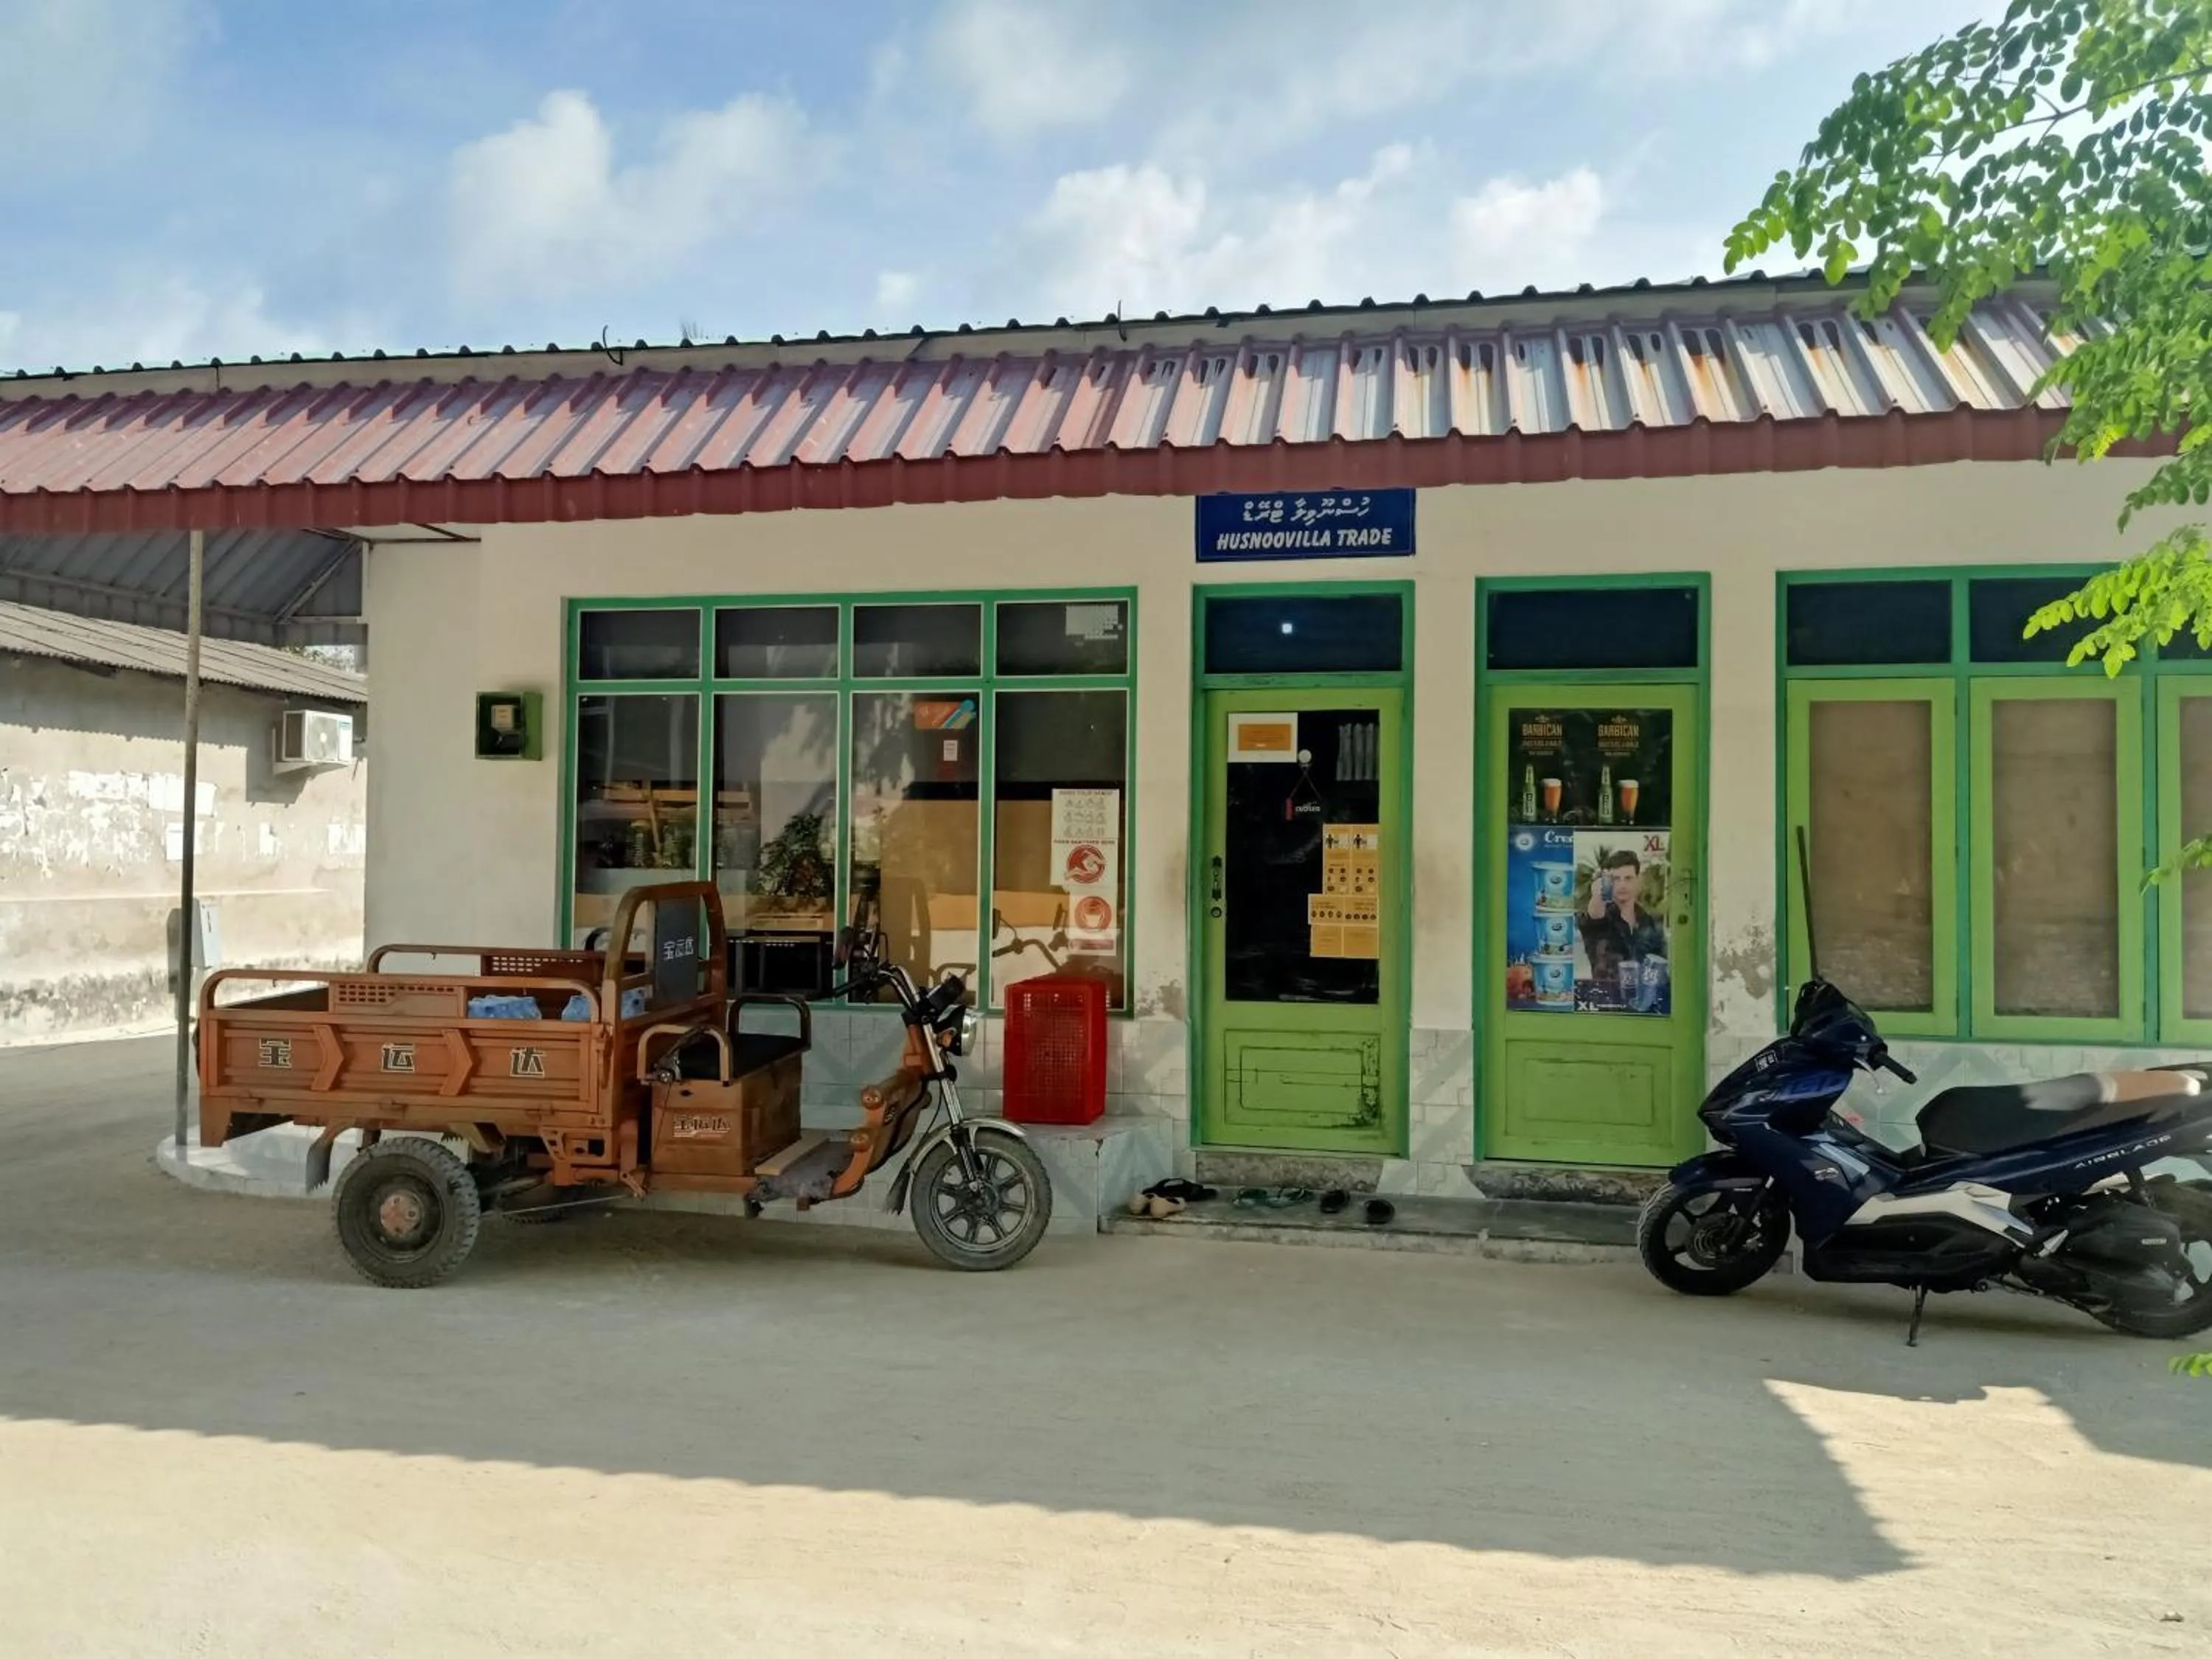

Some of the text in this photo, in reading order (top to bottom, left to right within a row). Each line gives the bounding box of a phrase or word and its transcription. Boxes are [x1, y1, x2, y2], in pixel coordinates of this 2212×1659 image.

[1217, 527, 1393, 551] HUSNOOVILLA TRADE
[1643, 834, 1665, 852] XL
[1576, 1001, 1599, 1011] XL
[259, 1038, 545, 1078] 宝 运 达
